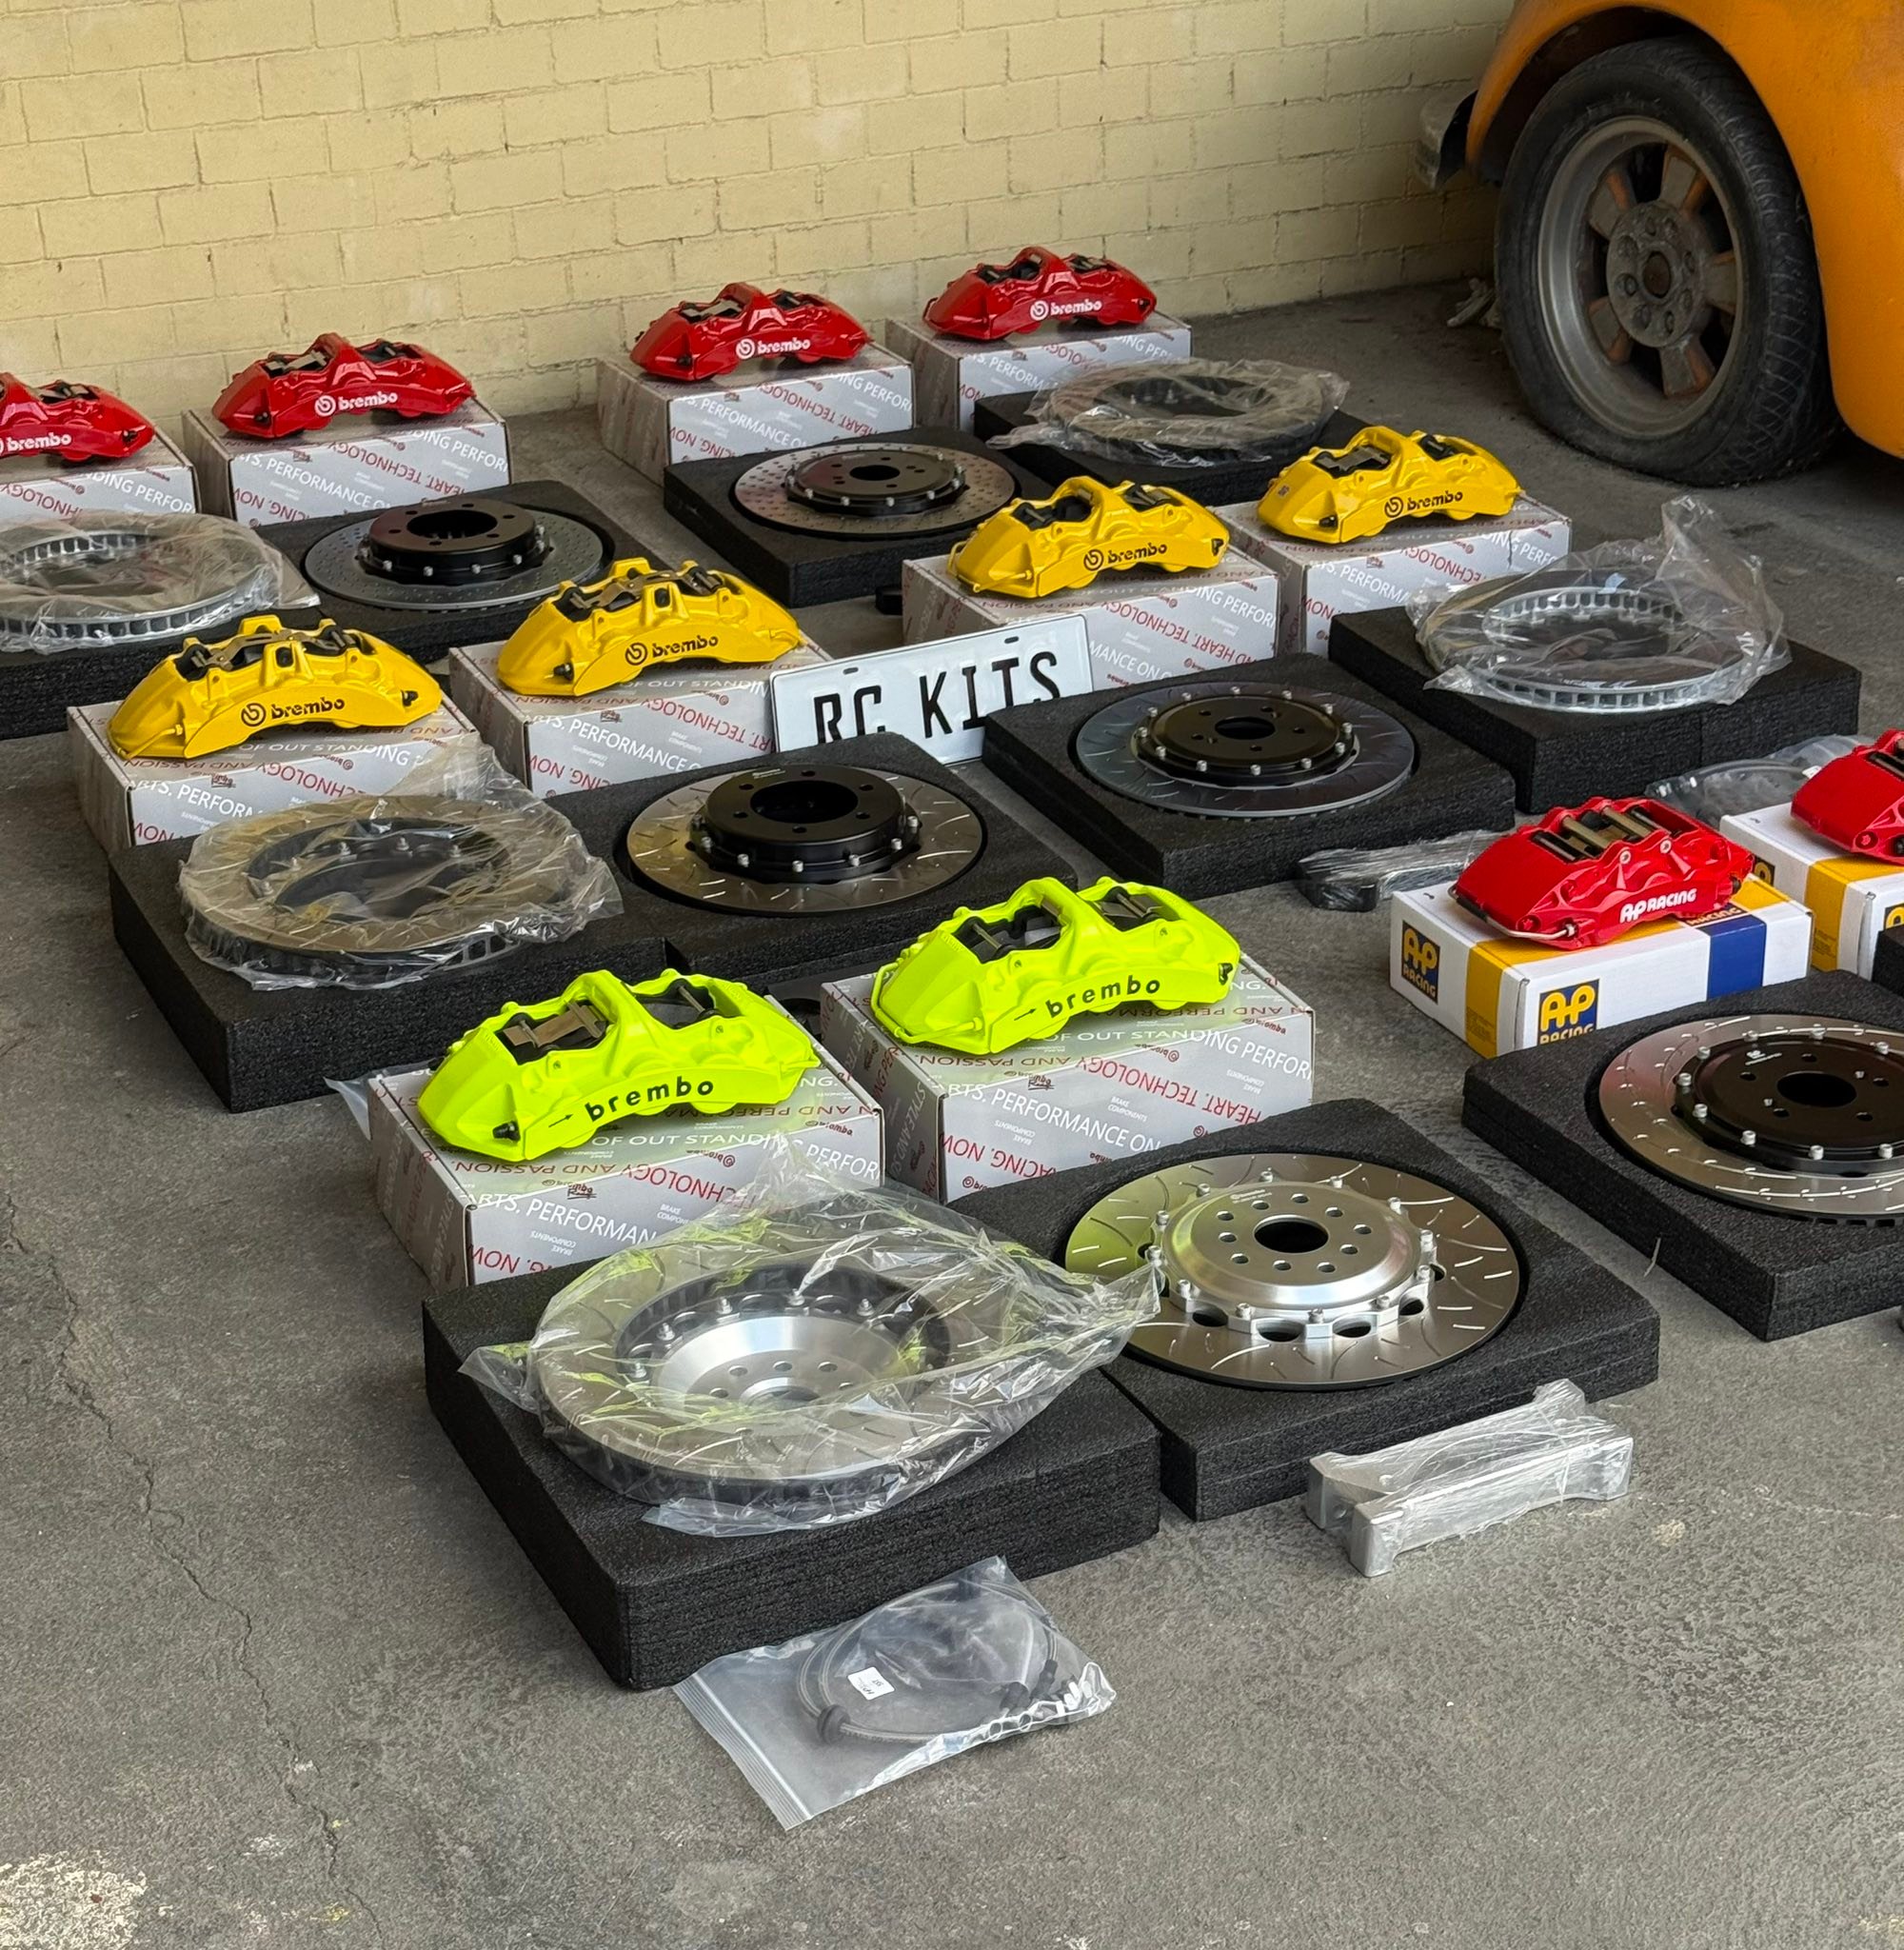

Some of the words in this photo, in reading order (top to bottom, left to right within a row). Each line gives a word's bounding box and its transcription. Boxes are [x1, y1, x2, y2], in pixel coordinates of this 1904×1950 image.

[1051, 298, 1102, 316] brembo
[757, 337, 810, 354] brembo
[338, 392, 399, 411] brembo
[757, 382, 836, 424] TECHNOLOGY
[700, 397, 791, 446] PERFORMANCE
[7, 431, 72, 452] brembo
[328, 440, 423, 485] TECHNOLOGY
[266, 456, 373, 509] PERFORMANCE
[425, 473, 466, 495] EART.
[1406, 489, 1464, 511] brembo
[1107, 541, 1169, 565] brembo
[1399, 546, 1482, 585] ECHNOLOGY
[1101, 600, 1191, 645] TECHNOLOGY
[652, 634, 719, 658] brembo
[1191, 632, 1237, 663] HEART.
[271, 696, 346, 720] brembo
[813, 685, 886, 745] RC
[919, 650, 1061, 739] KITS
[641, 697, 746, 744] TECHNOLOGY
[268, 743, 312, 751] OUT
[568, 718, 687, 773] PERFORMANCE
[256, 762, 367, 798] HNOLOGY
[1647, 887, 1697, 912] RACING
[1402, 965, 1438, 999] RACING
[1045, 975, 1160, 1018] brembo
[1539, 985, 1597, 1033] AP
[1233, 1005, 1282, 1015] AND
[1078, 1031, 1125, 1042] OUT
[1130, 1029, 1241, 1054] STANDING
[915, 1054, 1015, 1066] PASSION.
[1021, 1056, 1071, 1065] AND
[1076, 1055, 1199, 1107] TECHNOLOGY
[585, 1075, 714, 1124] brembo
[798, 1104, 852, 1115] AND
[1201, 1093, 1262, 1126] HEART.
[990, 1087, 1129, 1150] PERFORMANCE
[590, 1135, 624, 1146] OF
[628, 1134, 679, 1145] OUT
[450, 1160, 556, 1174] PASSION.
[563, 1163, 617, 1174] AND
